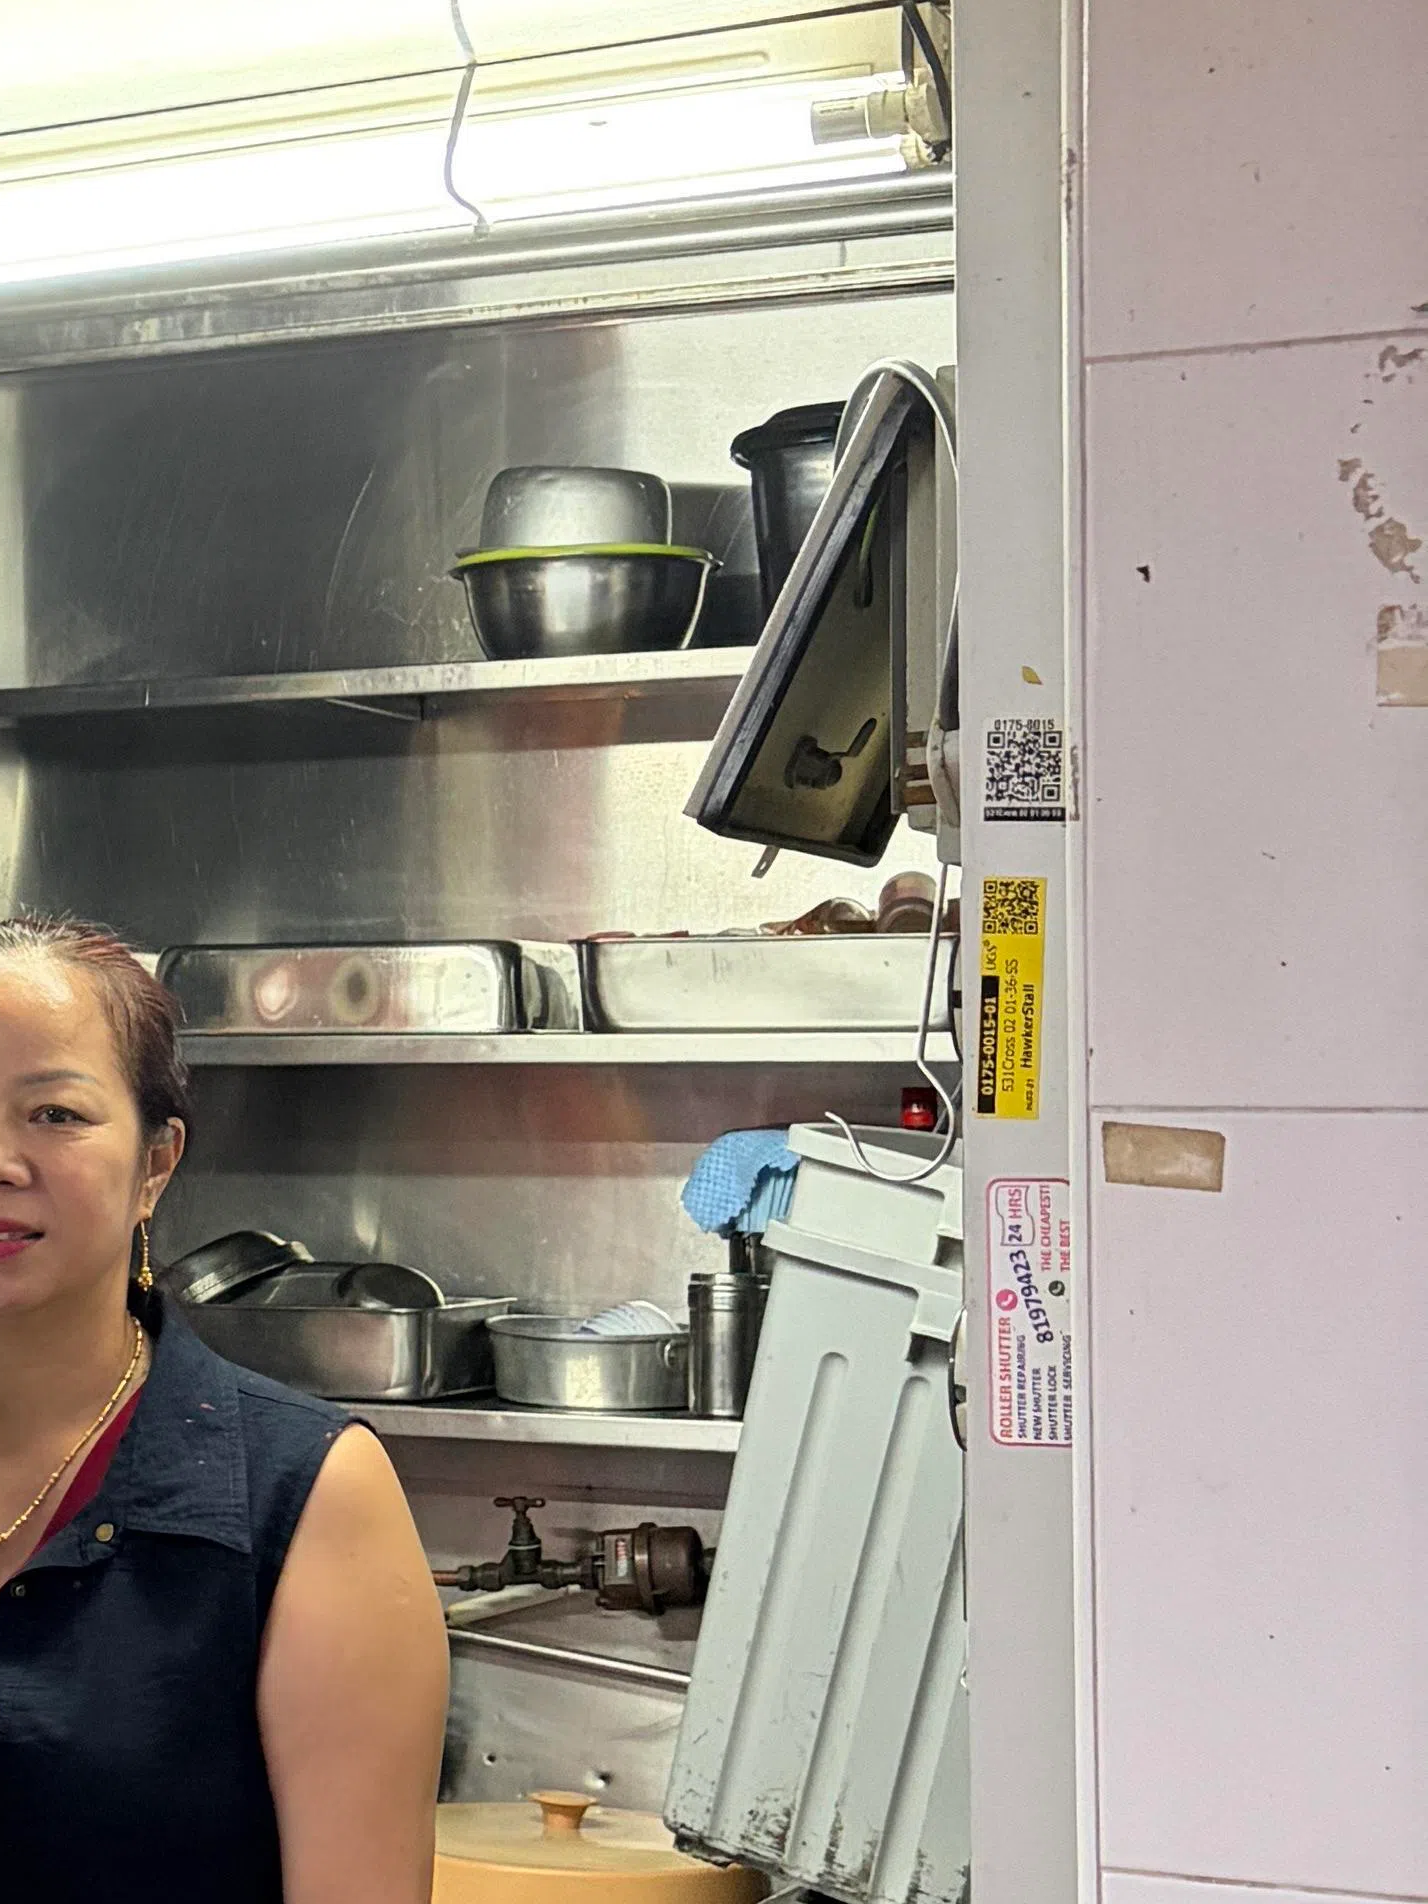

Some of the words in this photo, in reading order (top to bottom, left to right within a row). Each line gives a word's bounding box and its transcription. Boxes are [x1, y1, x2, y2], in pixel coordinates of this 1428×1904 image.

[994, 719, 1055, 731] 0175-0015
[981, 996, 997, 1096] 0175-0015-01
[1003, 1019, 1016, 1033] 02
[1019, 984, 1035, 1069] HawkerStall
[1001, 1036, 1016, 1092] 531Cross
[1007, 1188, 1022, 1219] HRS
[1007, 1224, 1022, 1242] 24
[1059, 1219, 1070, 1247] BEST
[1041, 1250, 1052, 1271] THE
[1059, 1250, 1070, 1272] THE
[1009, 1249, 1055, 1344] 81979423
[998, 1317, 1012, 1381] SHUTTER
[1031, 1367, 1042, 1413] SHUTTER
[1047, 1365, 1057, 1393] LOCK
[999, 1386, 1013, 1438] ROLLER
[1016, 1393, 1027, 1439] SHUTTER
[1048, 1394, 1058, 1441] SHUTTER
